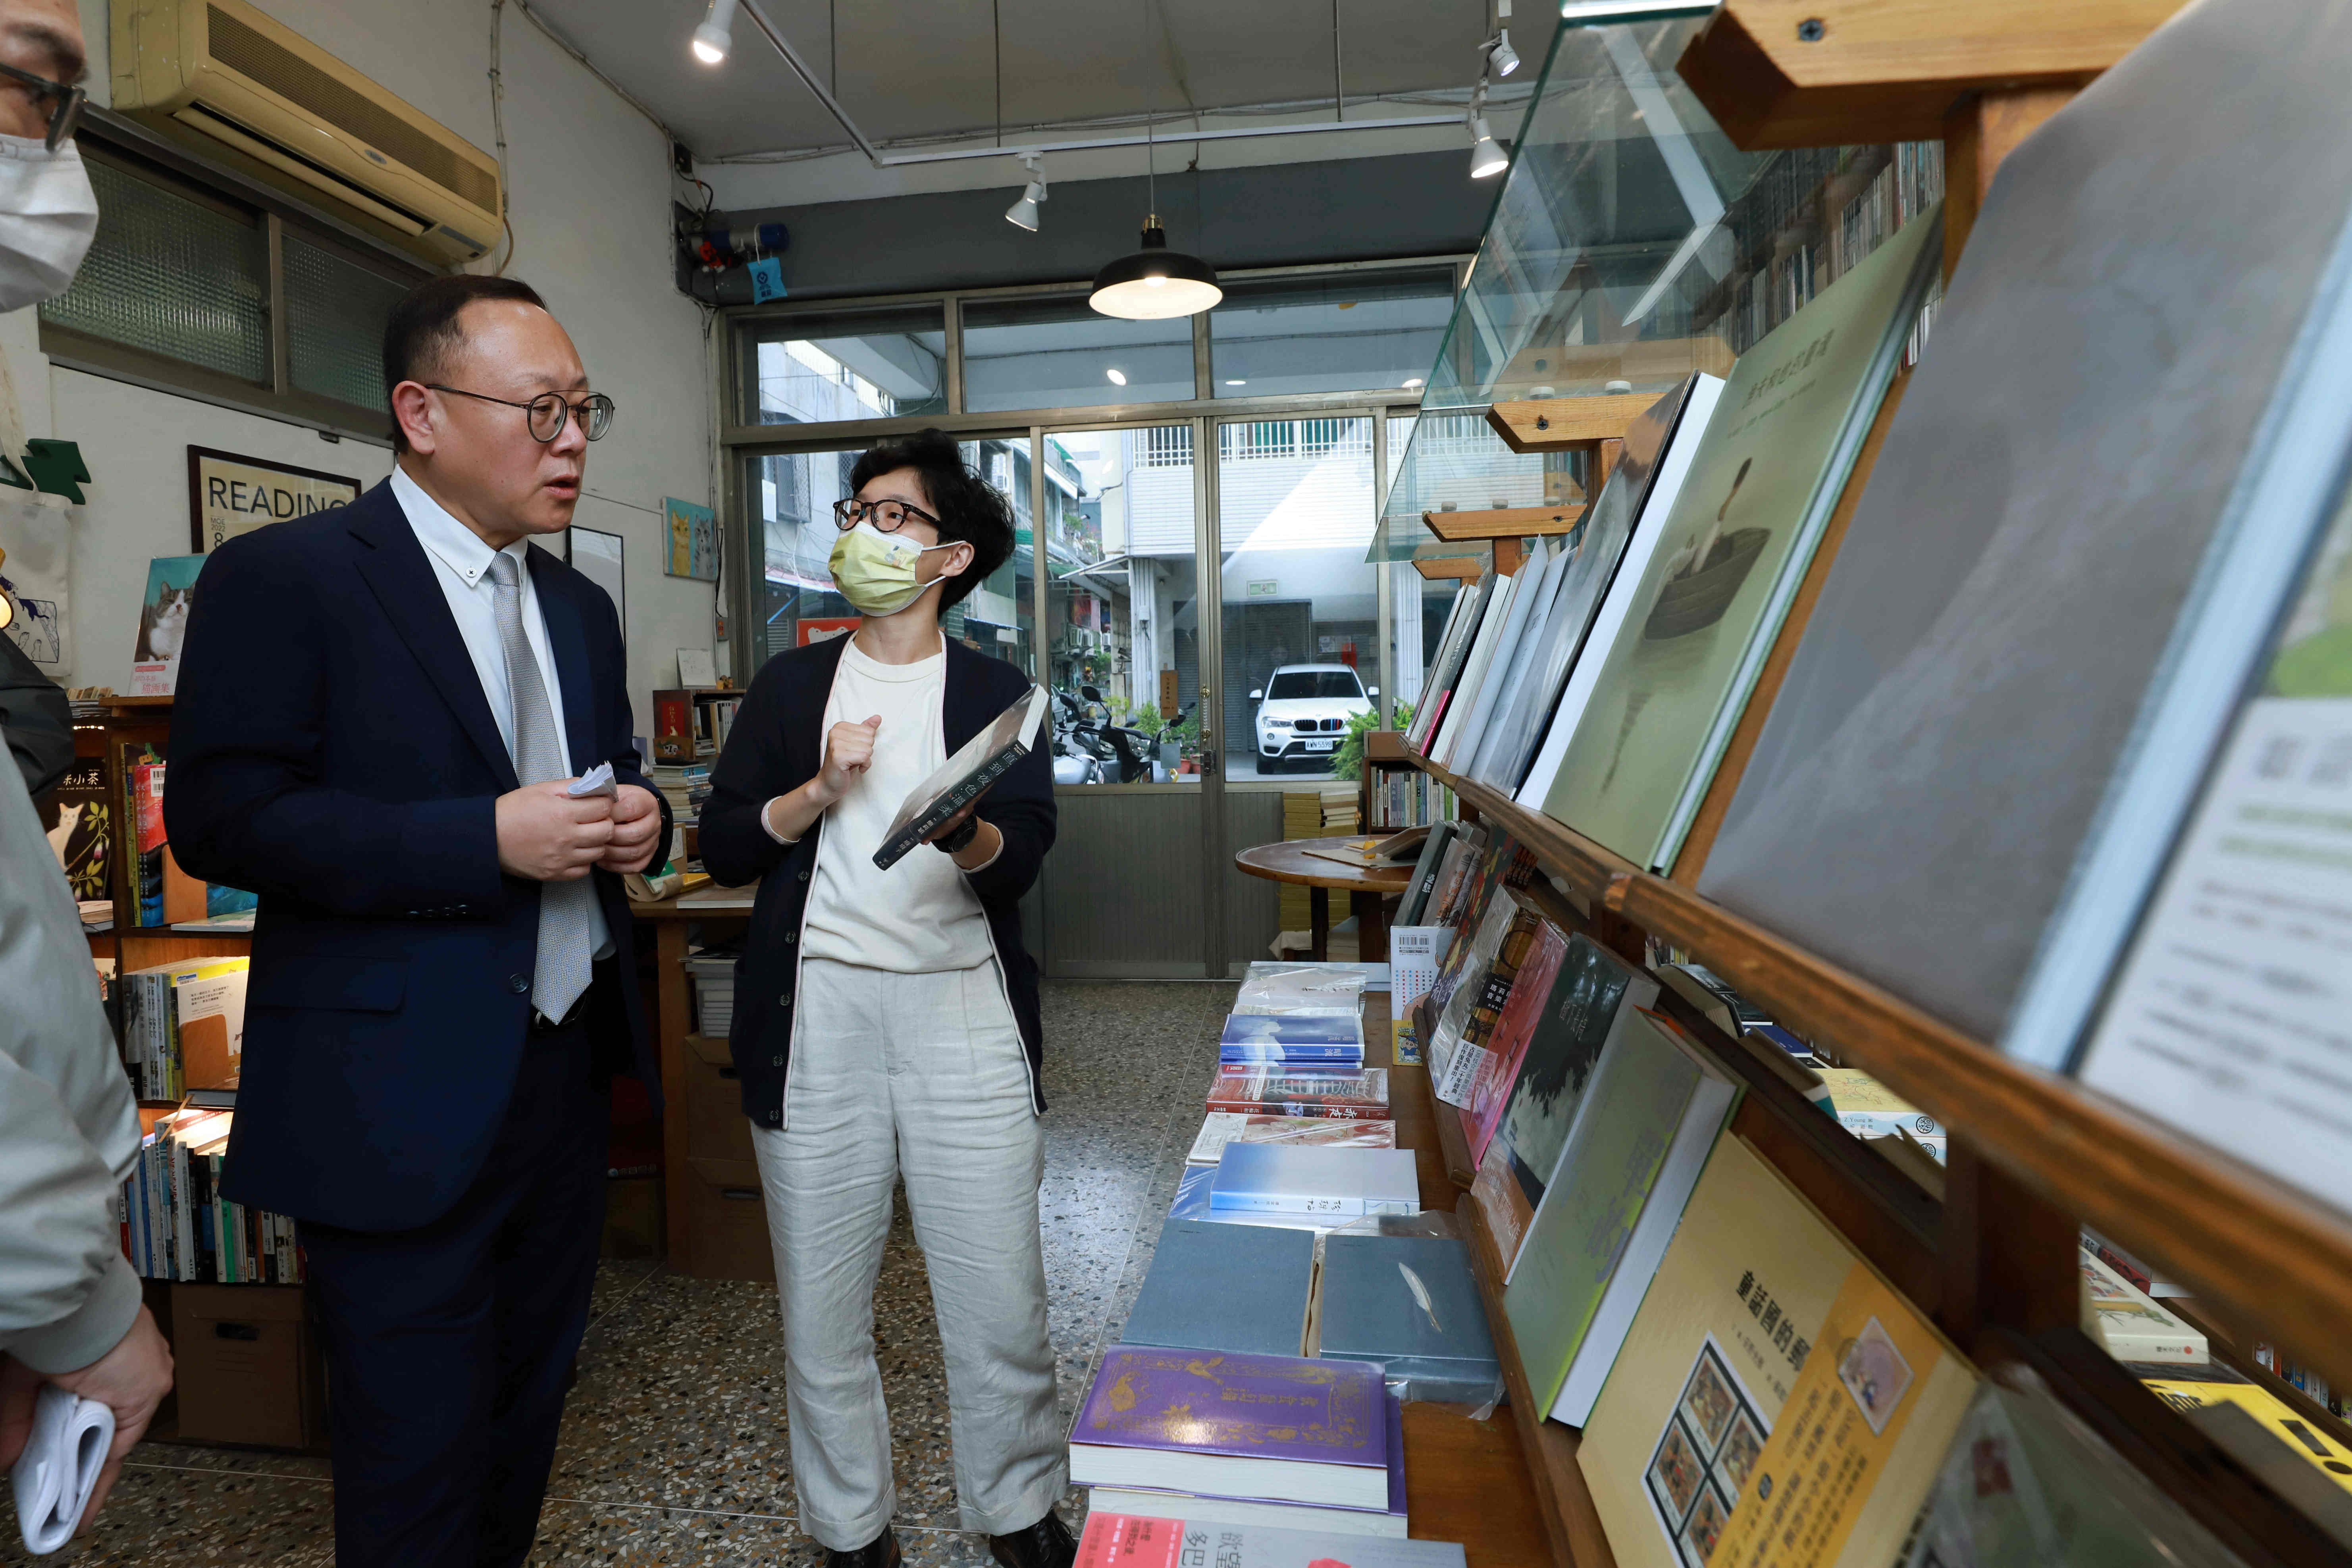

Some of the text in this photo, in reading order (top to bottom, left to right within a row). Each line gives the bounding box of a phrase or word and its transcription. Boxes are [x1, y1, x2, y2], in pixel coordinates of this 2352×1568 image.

[938, 750, 1019, 818] 直到夜色溫柔
